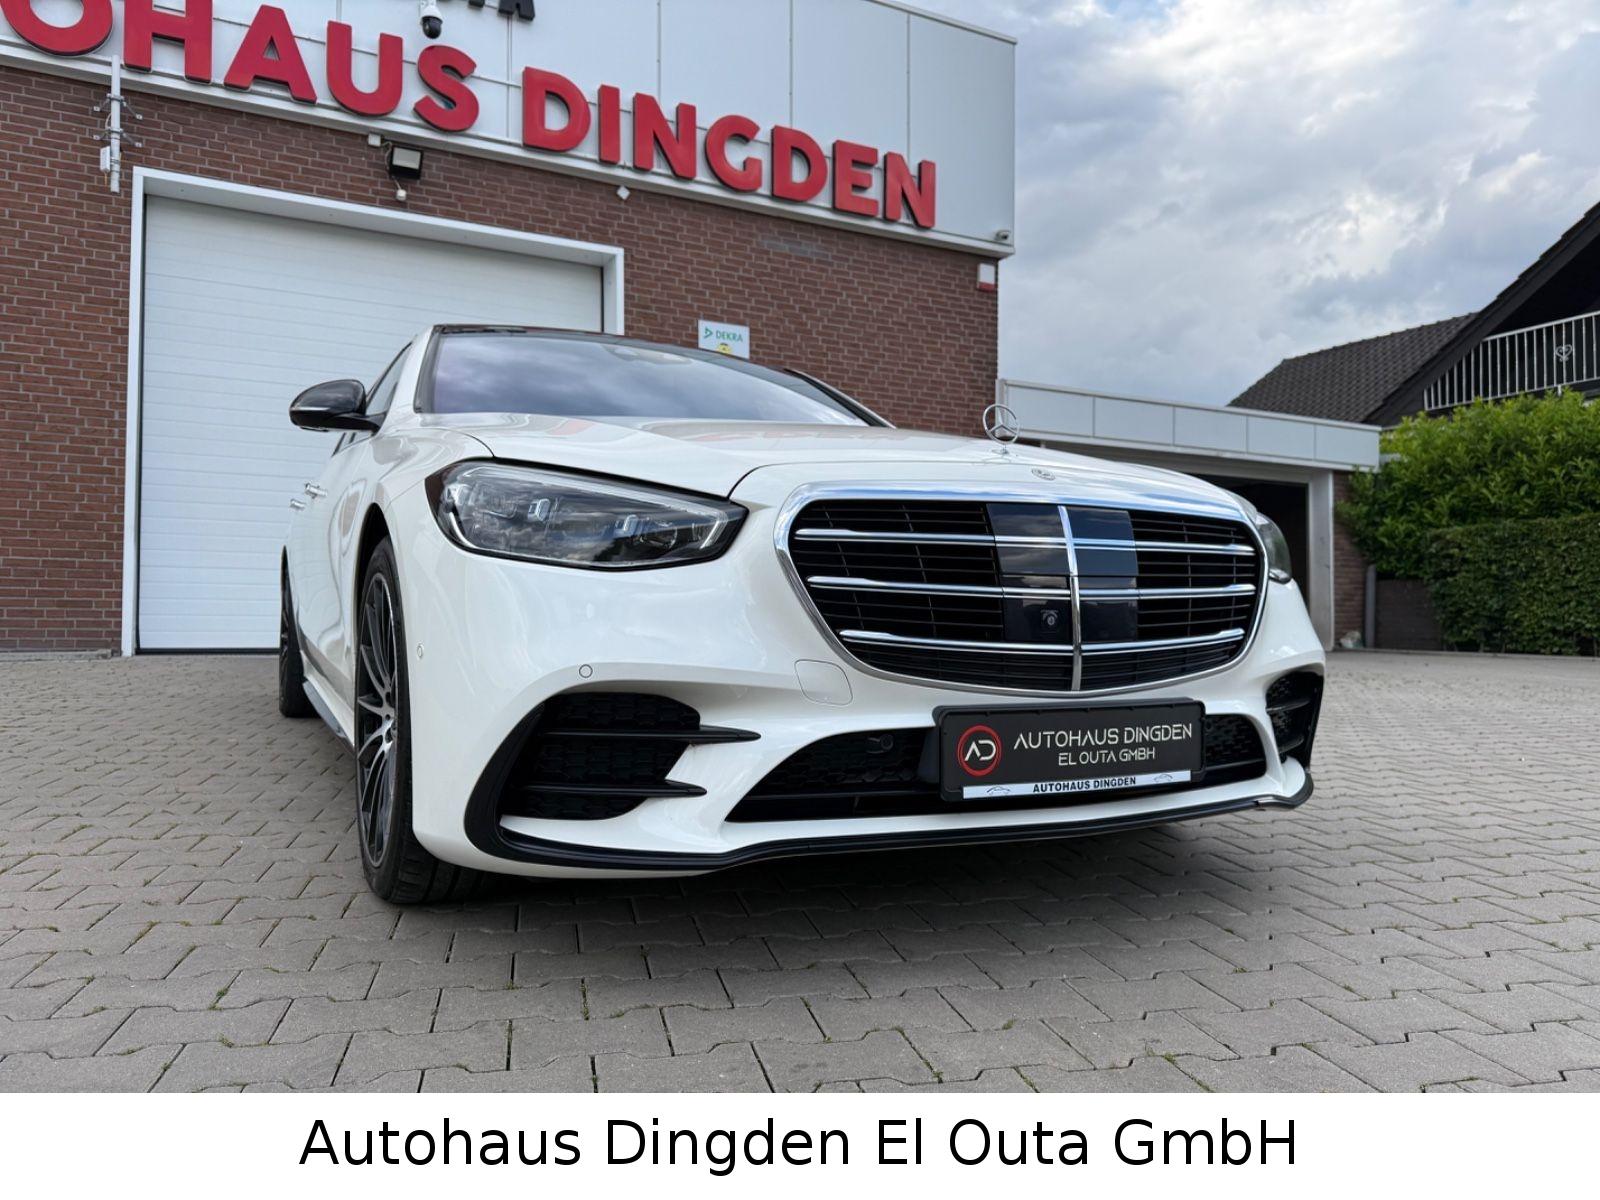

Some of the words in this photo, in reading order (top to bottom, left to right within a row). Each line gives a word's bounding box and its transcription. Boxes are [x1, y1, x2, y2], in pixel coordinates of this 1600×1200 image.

[522, 66, 936, 229] DINGDEN
[715, 330, 743, 342] DEKRA
[1013, 727, 1119, 750] AUTOHAUS
[1124, 723, 1192, 742] DINGDEN
[1058, 752, 1077, 766] EL
[1079, 750, 1117, 765] OUTA
[1119, 747, 1156, 761] GMBH
[1032, 778, 1091, 793] AUTOHAUS
[1093, 776, 1137, 791] DINGDEN
